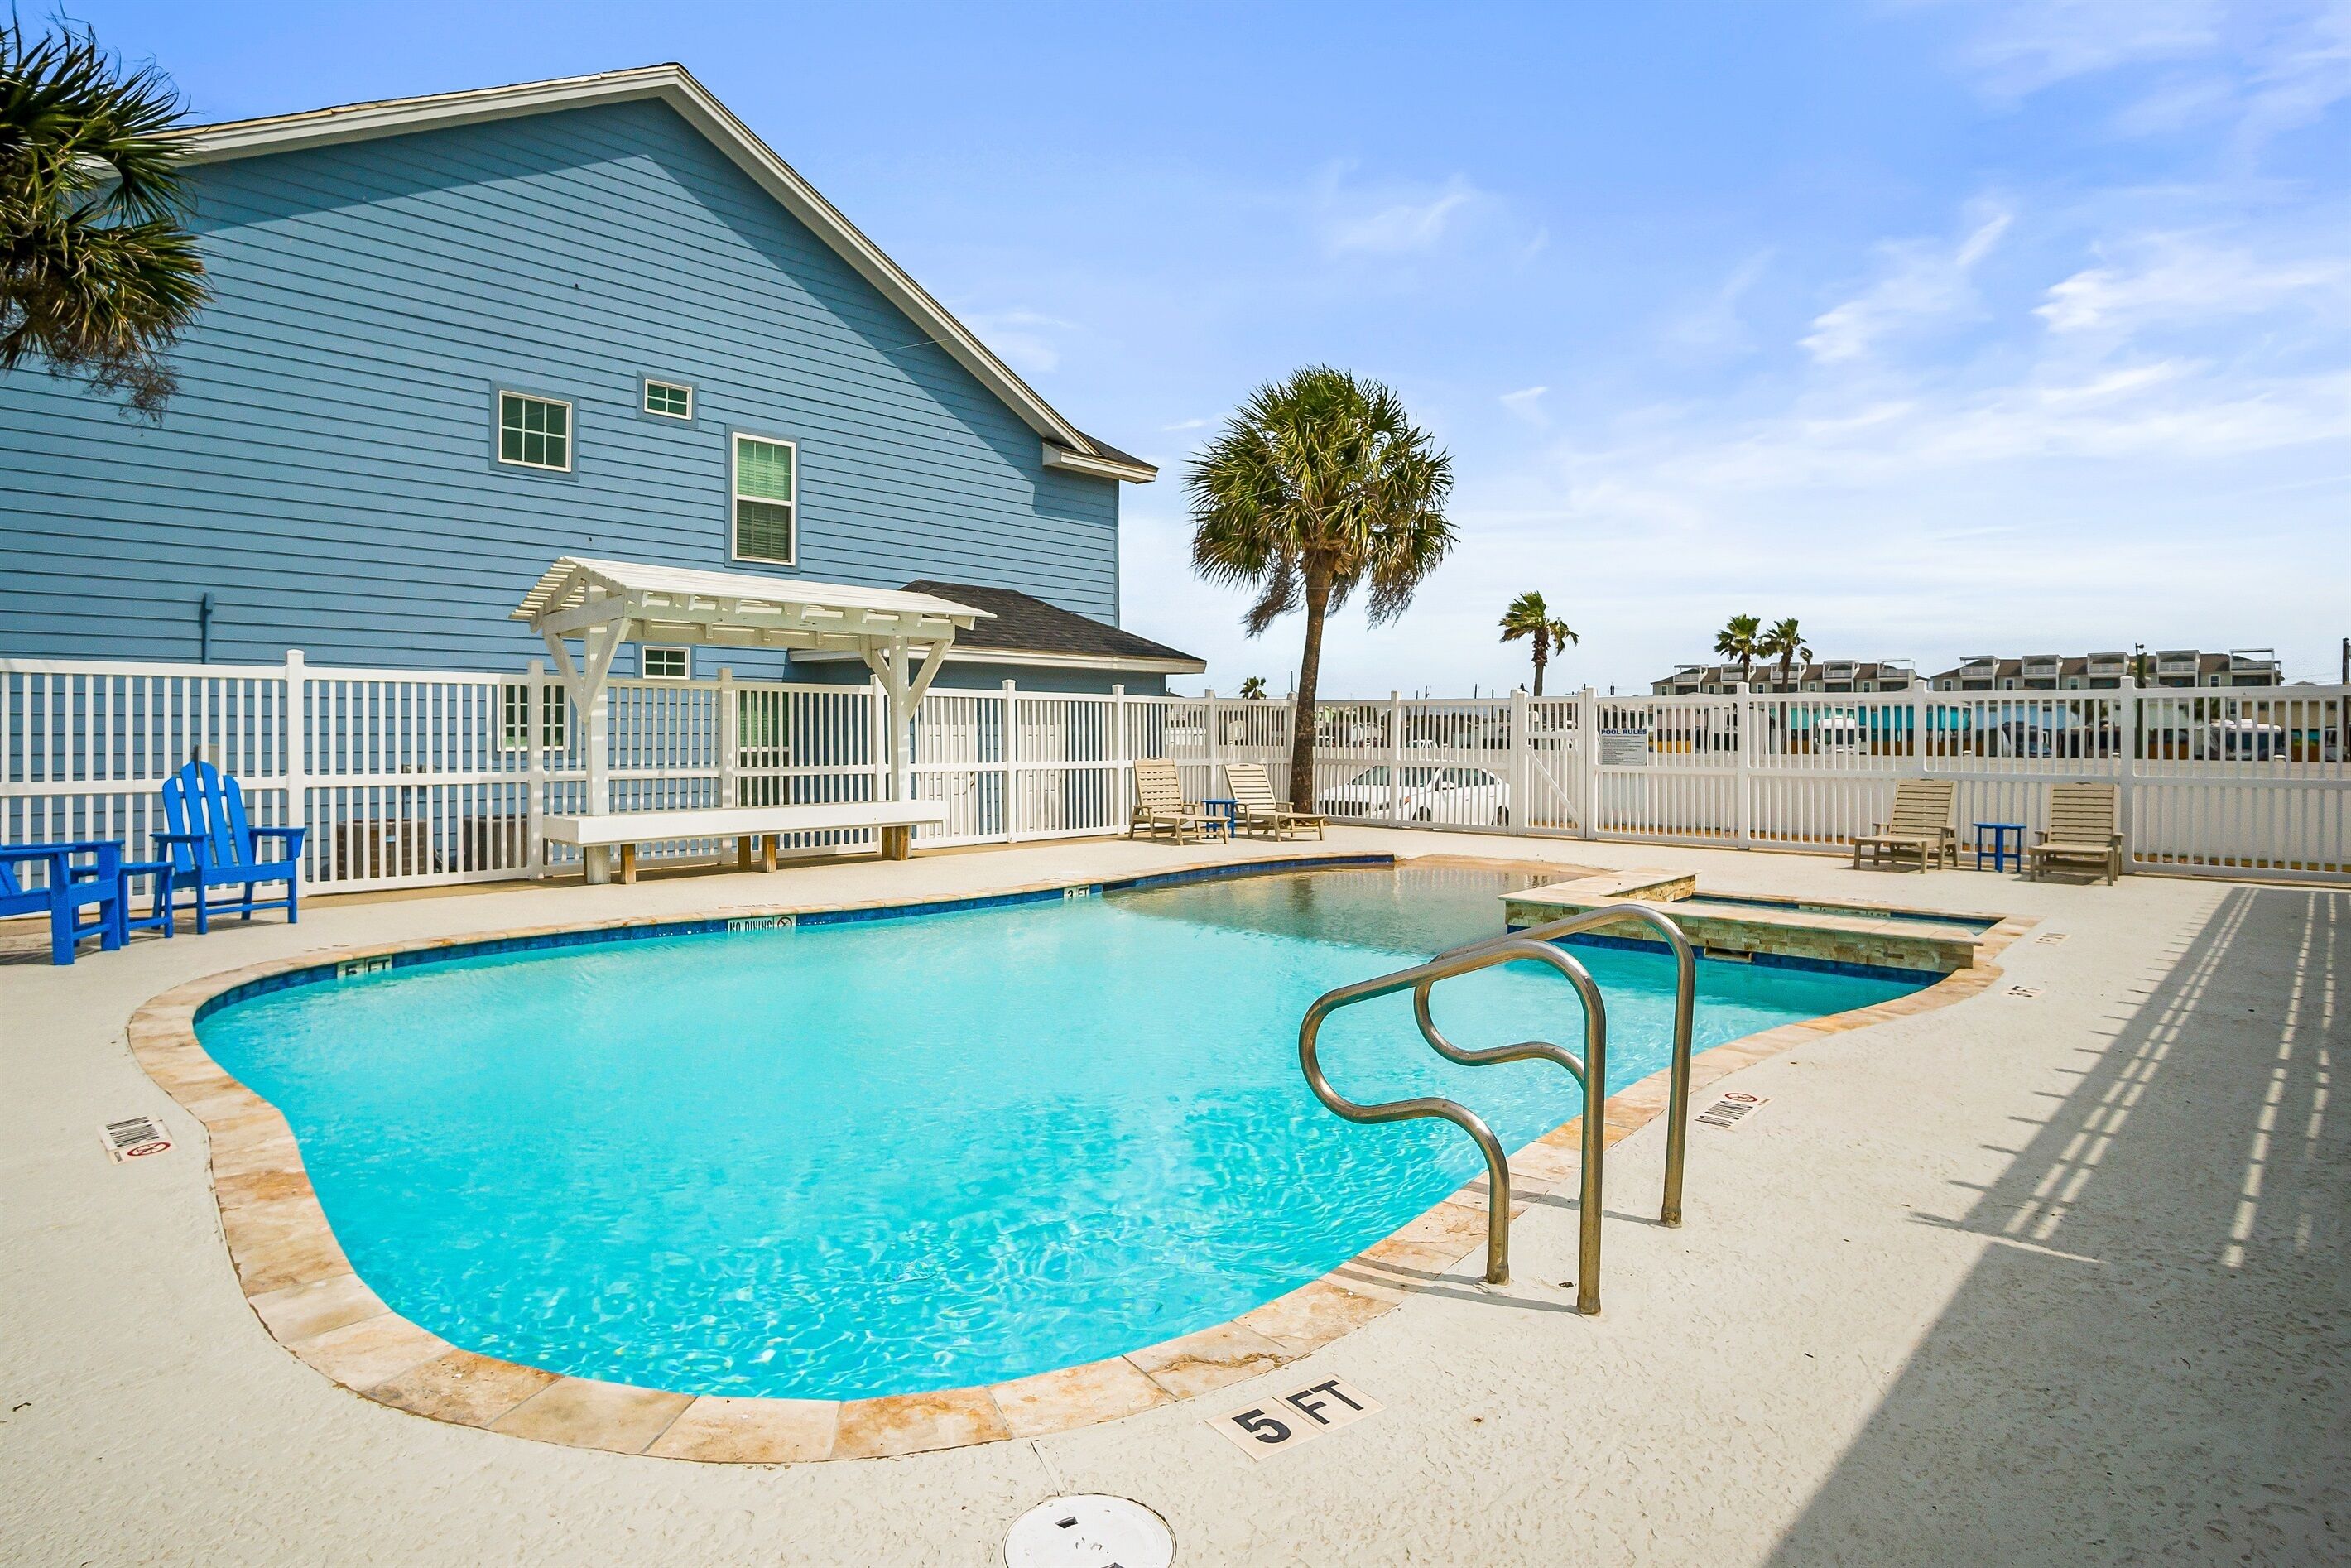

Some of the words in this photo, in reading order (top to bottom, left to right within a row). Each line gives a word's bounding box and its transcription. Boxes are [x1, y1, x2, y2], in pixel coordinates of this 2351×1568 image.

[729, 921, 741, 932] NO
[744, 919, 772, 932] DIVING
[368, 958, 390, 973] FT
[1231, 1408, 1291, 1444] 5
[1285, 1379, 1364, 1426] FT
